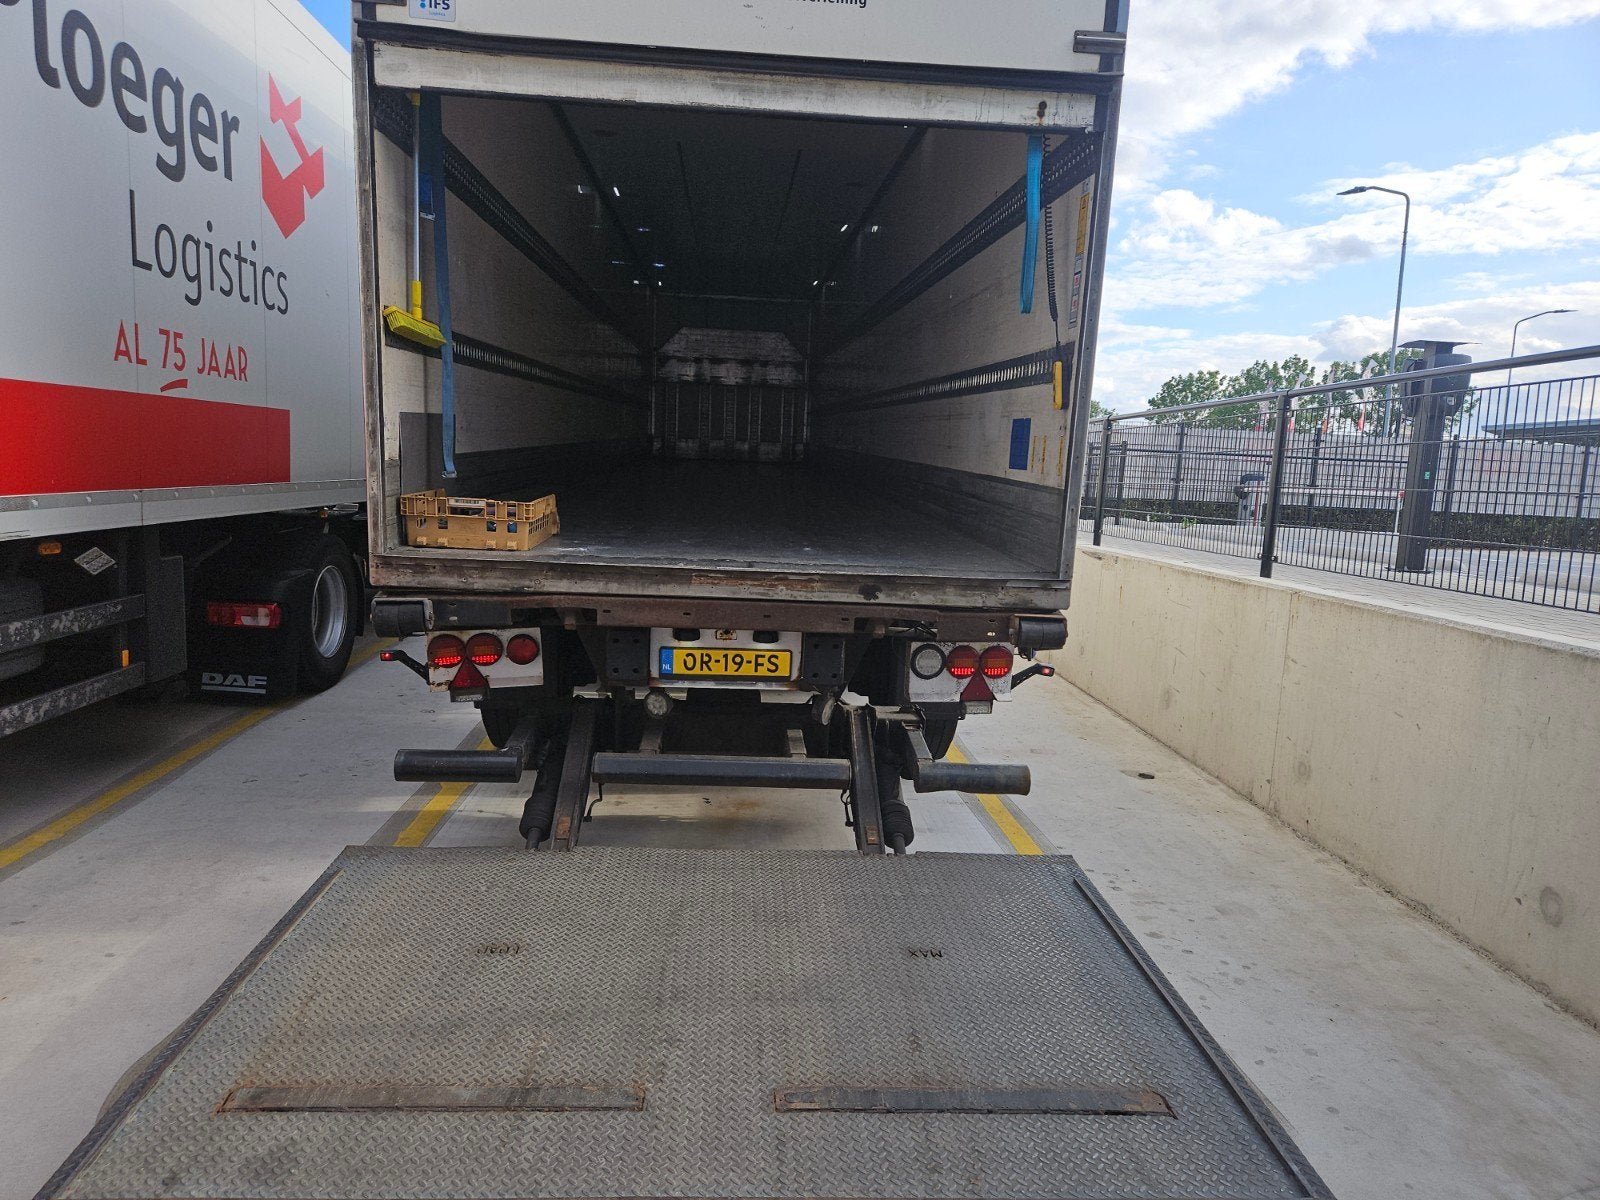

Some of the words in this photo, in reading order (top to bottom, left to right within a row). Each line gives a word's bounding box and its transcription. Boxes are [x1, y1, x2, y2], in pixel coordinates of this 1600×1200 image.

[0, 0, 240, 182] loeger
[130, 189, 289, 315] Logistics
[113, 320, 147, 366] AL
[158, 328, 186, 372] 75
[197, 338, 248, 382] JAAR
[201, 672, 268, 687] DAF
[683, 652, 780, 673] OR-19-FS
